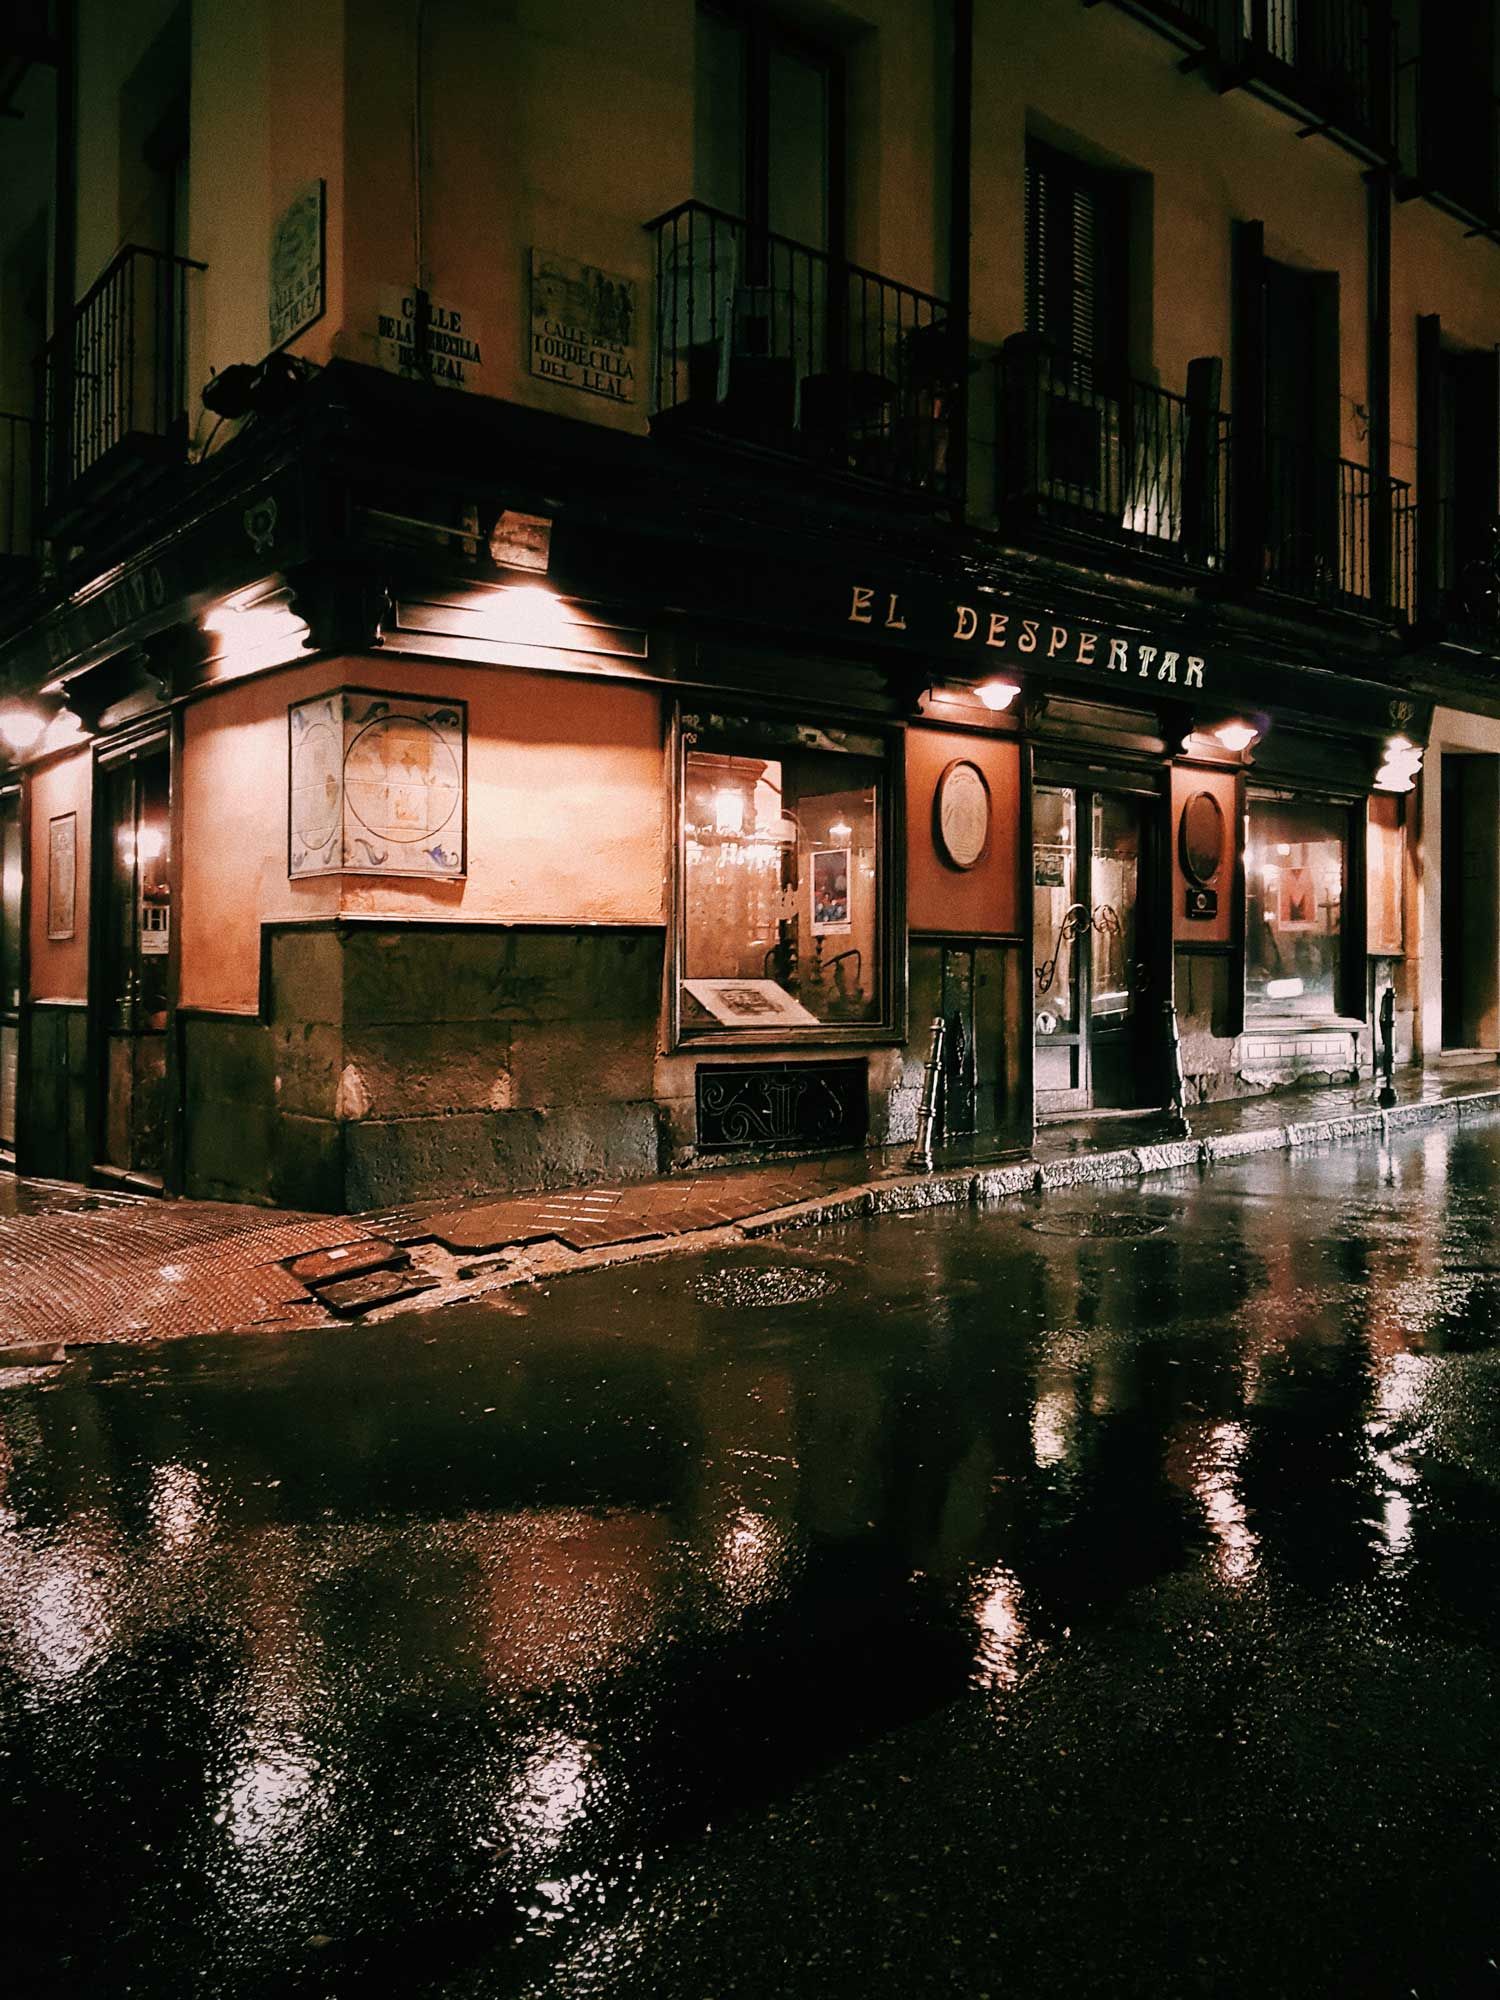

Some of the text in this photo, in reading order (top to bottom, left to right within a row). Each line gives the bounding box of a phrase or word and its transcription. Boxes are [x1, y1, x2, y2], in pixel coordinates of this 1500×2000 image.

[402, 298, 461, 333] CLLE
[544, 320, 588, 347] CALLE
[533, 335, 633, 380] TORRECILLA
[540, 360, 627, 401] DEL LEAL
[848, 585, 1206, 689] EL DESPERTAR
